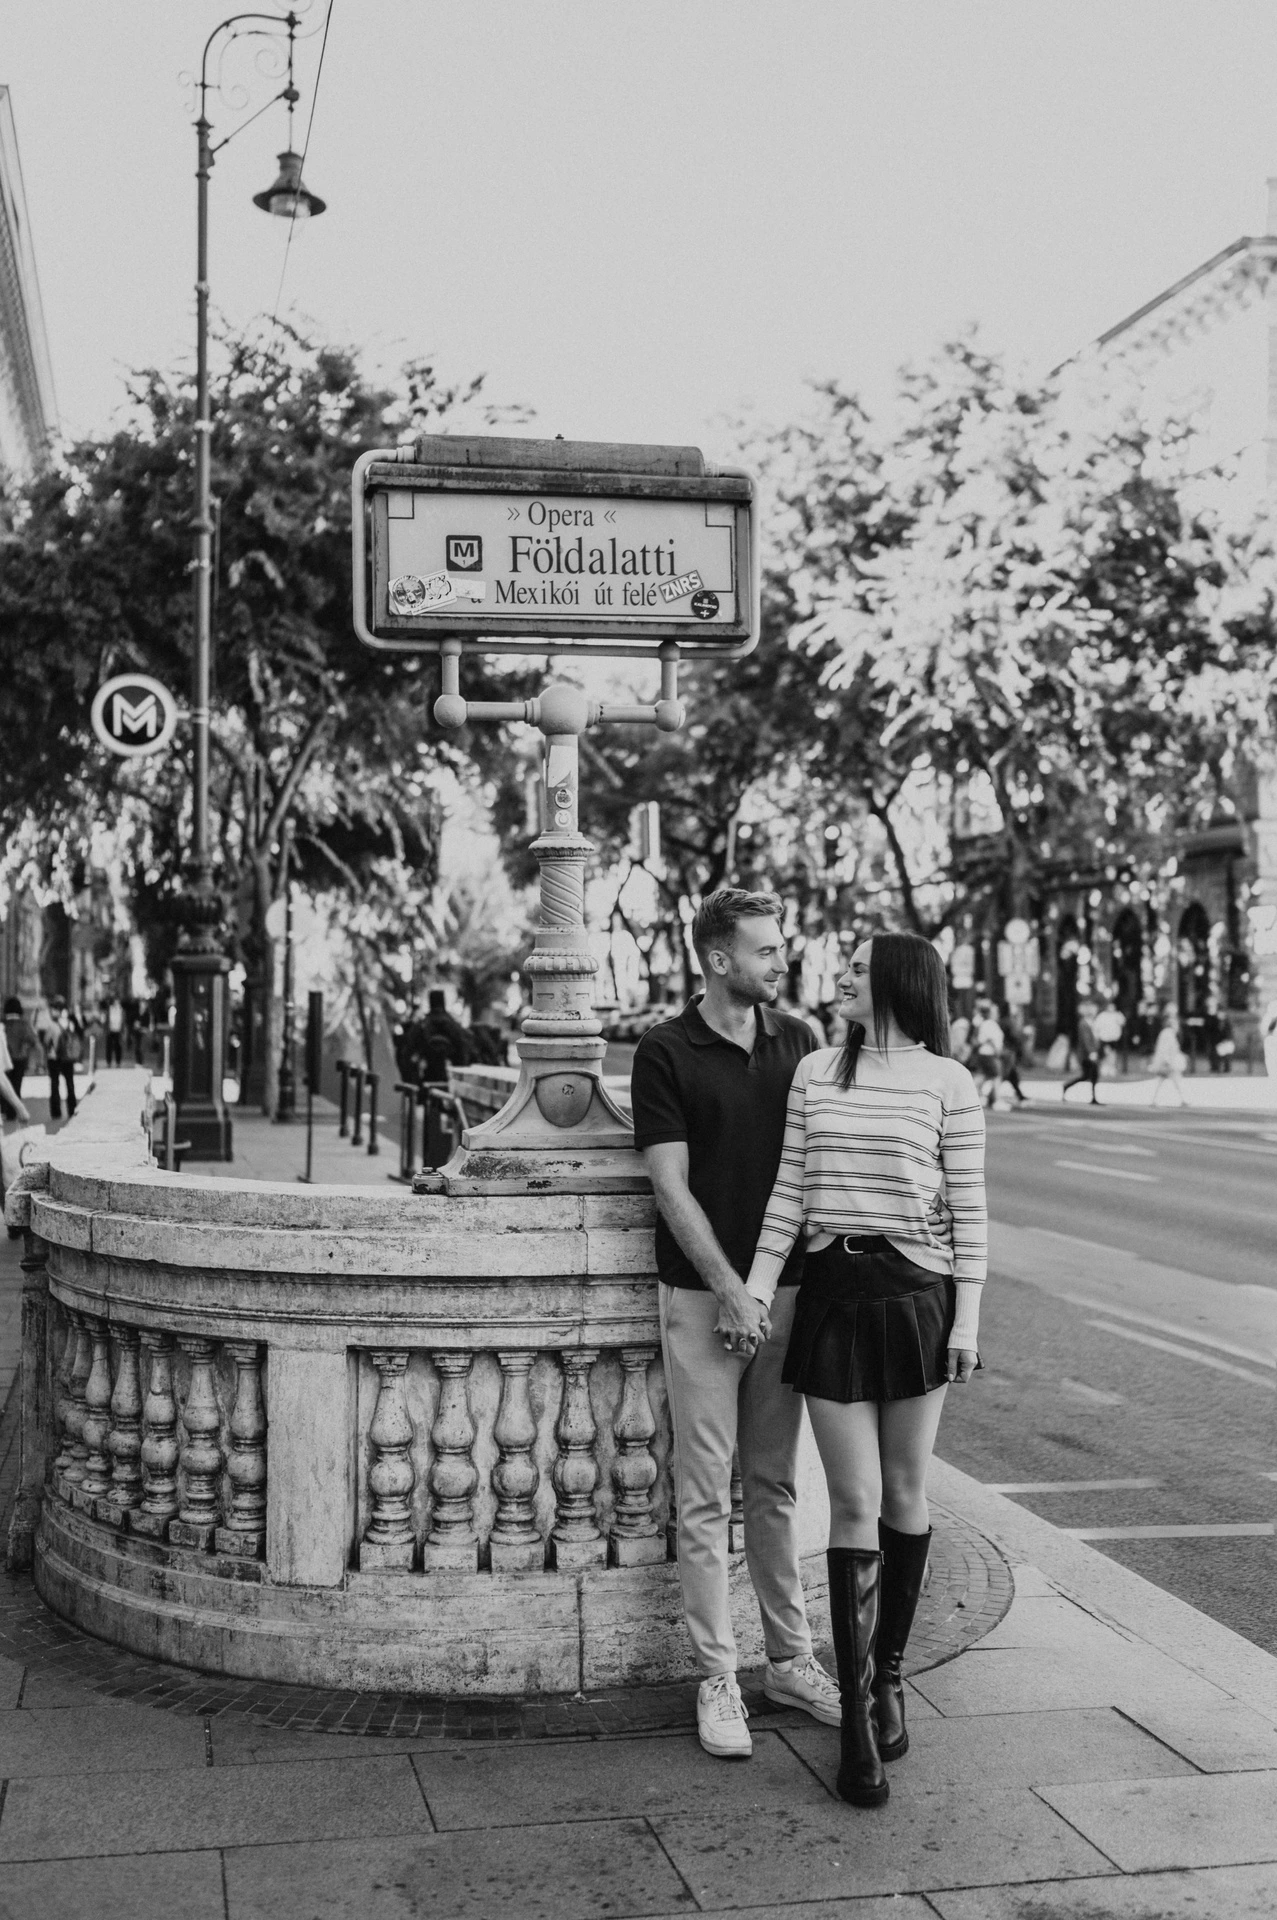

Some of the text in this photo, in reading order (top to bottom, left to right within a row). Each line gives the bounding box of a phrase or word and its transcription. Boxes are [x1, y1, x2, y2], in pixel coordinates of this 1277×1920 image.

[528, 501, 594, 532] Opera
[454, 542, 474, 558] M
[508, 535, 677, 576] Földalatti
[494, 579, 657, 607] Mexikói út felé
[661, 573, 701, 602] ZNRS
[112, 692, 157, 739] M
